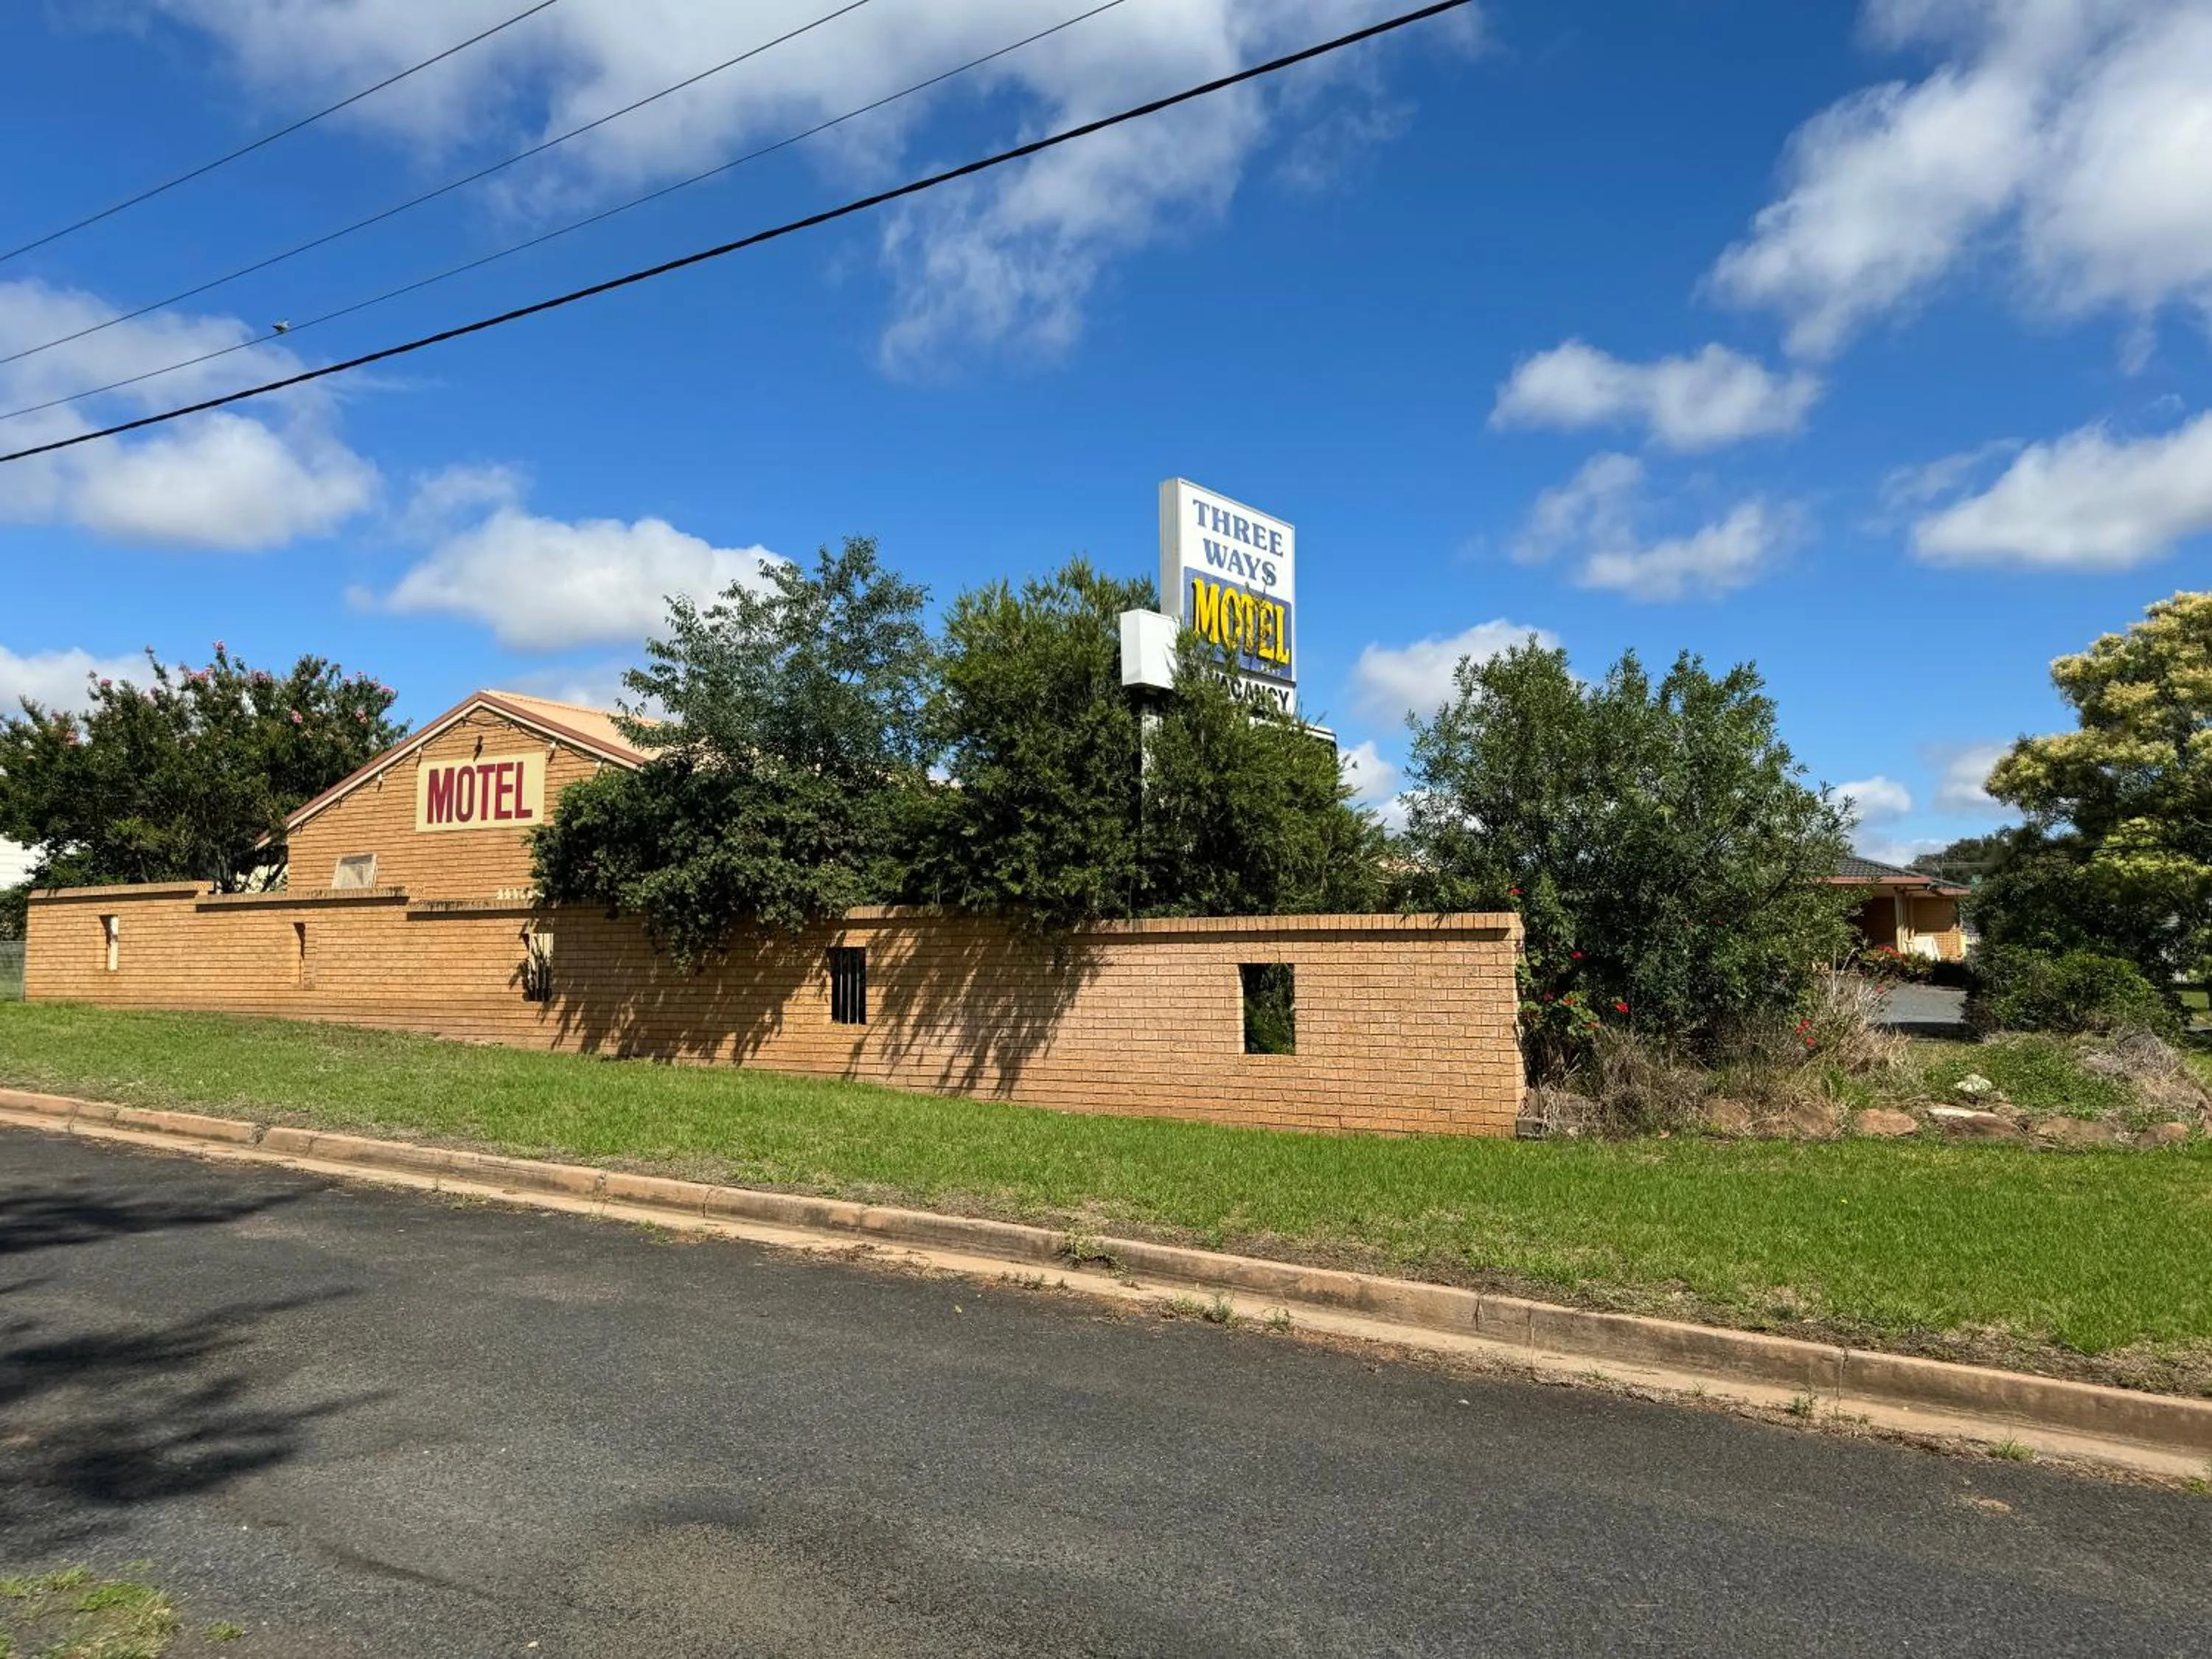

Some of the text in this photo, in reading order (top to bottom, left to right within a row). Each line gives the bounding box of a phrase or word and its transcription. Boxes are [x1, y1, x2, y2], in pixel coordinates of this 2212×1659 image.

[1192, 498, 1284, 557] THREE
[1203, 538, 1277, 587] WAYS
[1192, 577, 1290, 664] MOTEL
[1212, 672, 1290, 711] ACANCY
[427, 762, 532, 824] MOTEL
